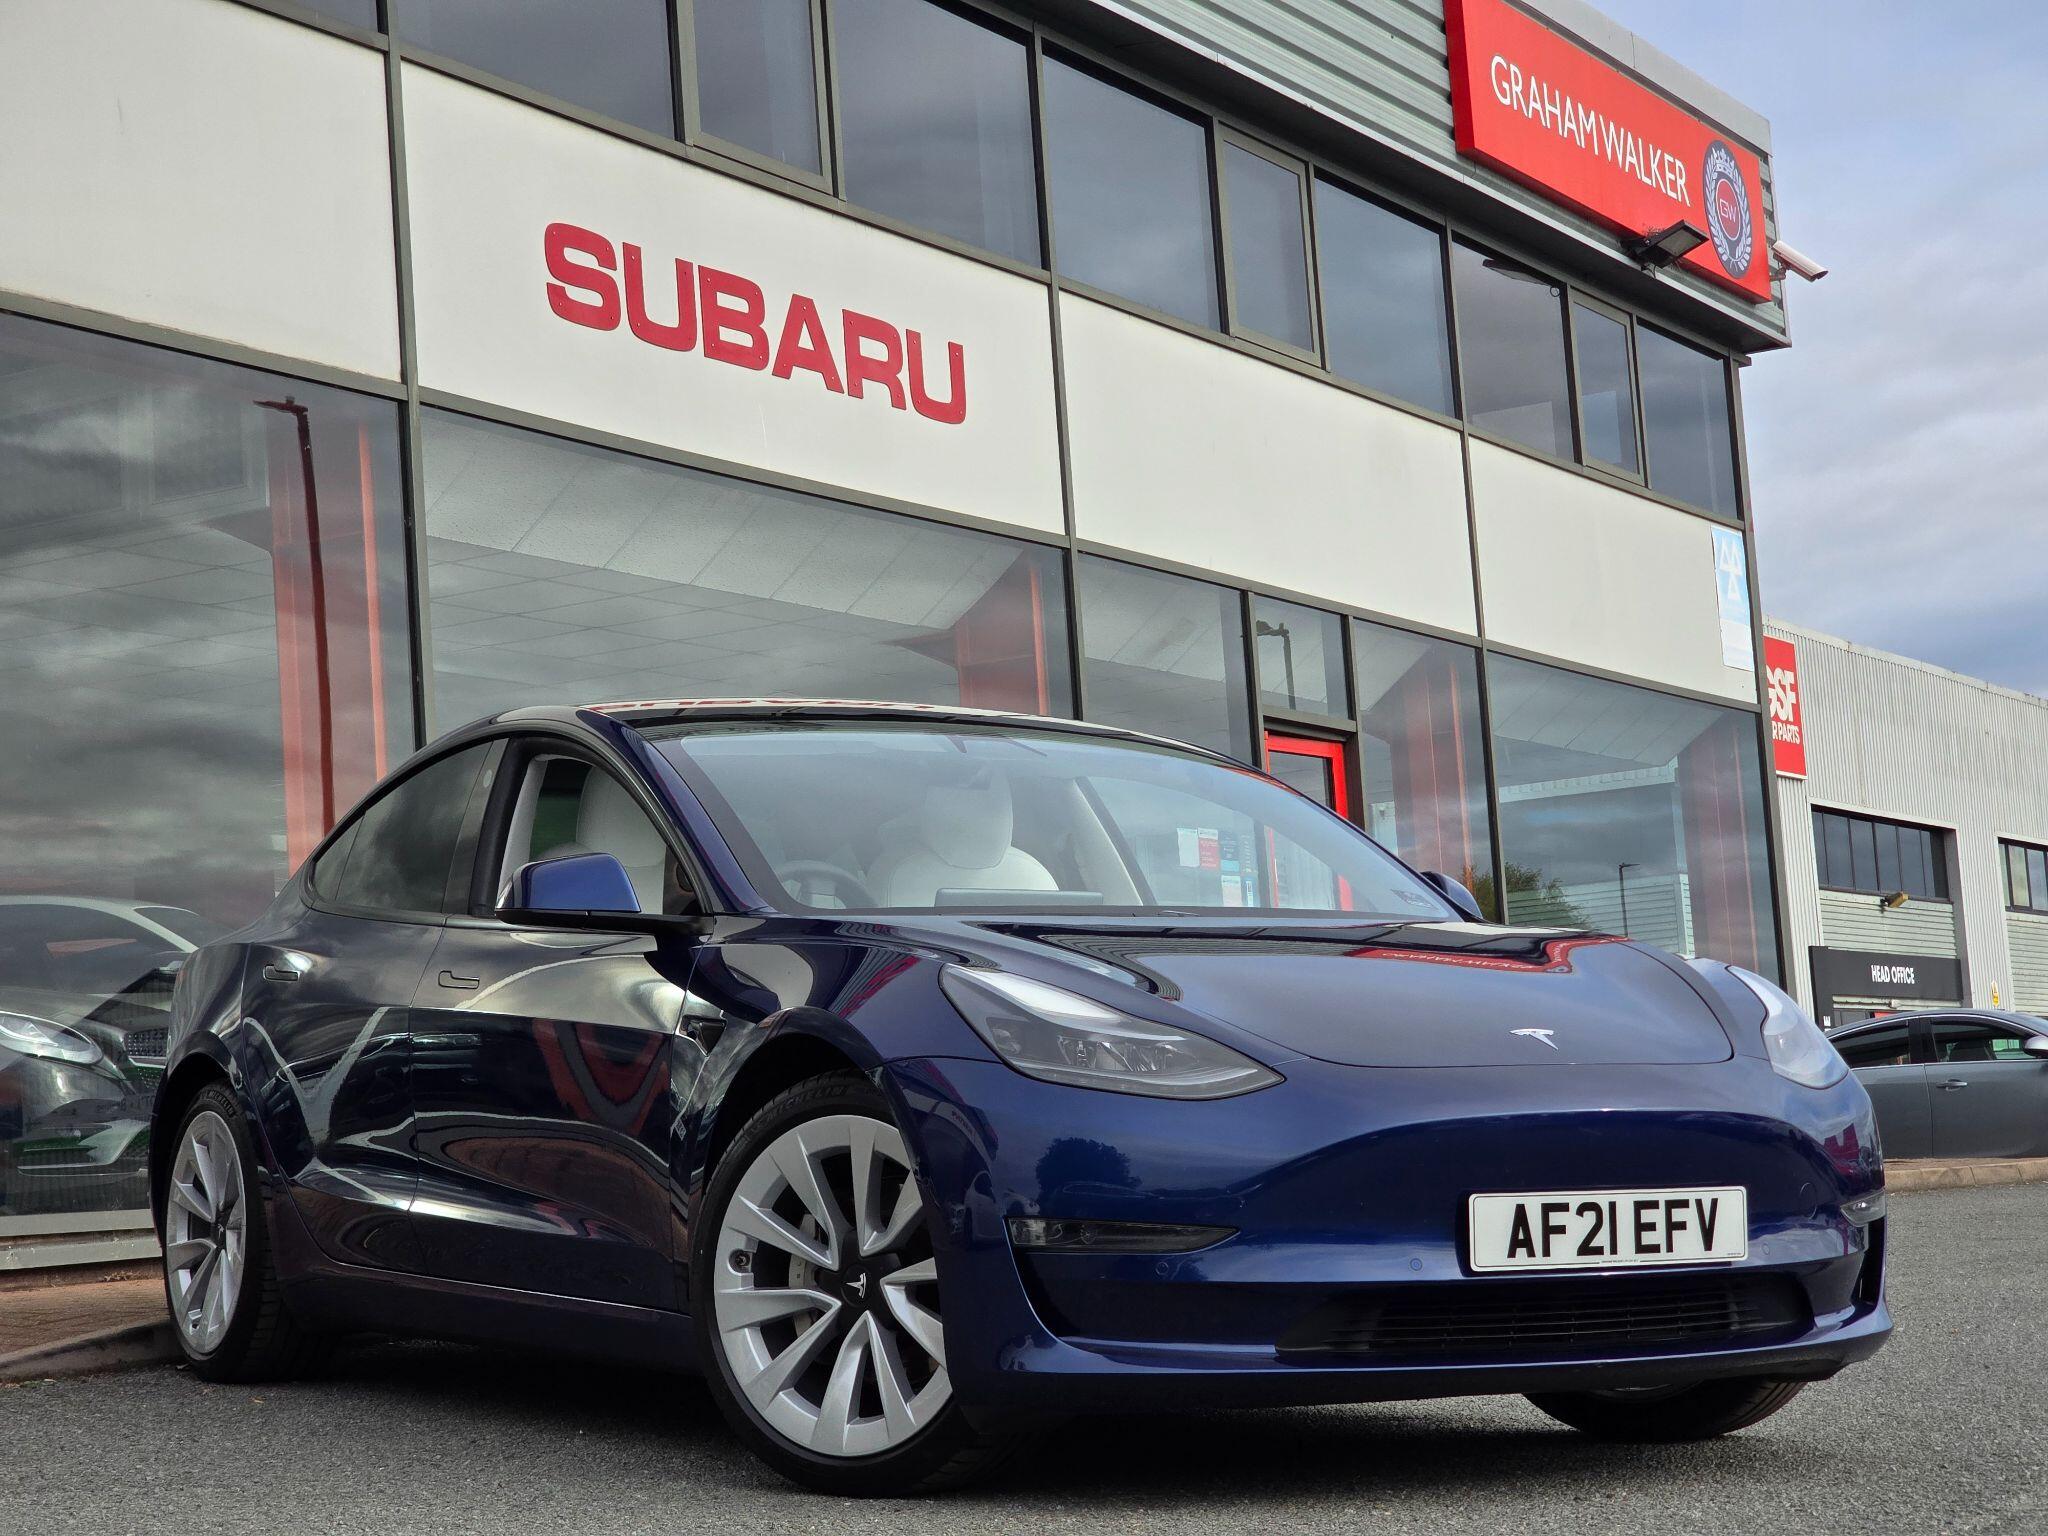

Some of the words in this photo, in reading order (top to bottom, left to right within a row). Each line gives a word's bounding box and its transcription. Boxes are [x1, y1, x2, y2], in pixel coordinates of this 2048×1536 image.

[1490, 55, 1599, 156] GRAHAM
[1599, 114, 1691, 207] WALKER
[544, 222, 967, 425] SUBARU
[1777, 722, 1801, 745] PARTS
[1871, 964, 1890, 983] HEAD
[1891, 966, 1915, 984] OFFICE
[1507, 1200, 1618, 1259] AF21
[1633, 1197, 1719, 1256] EFV
